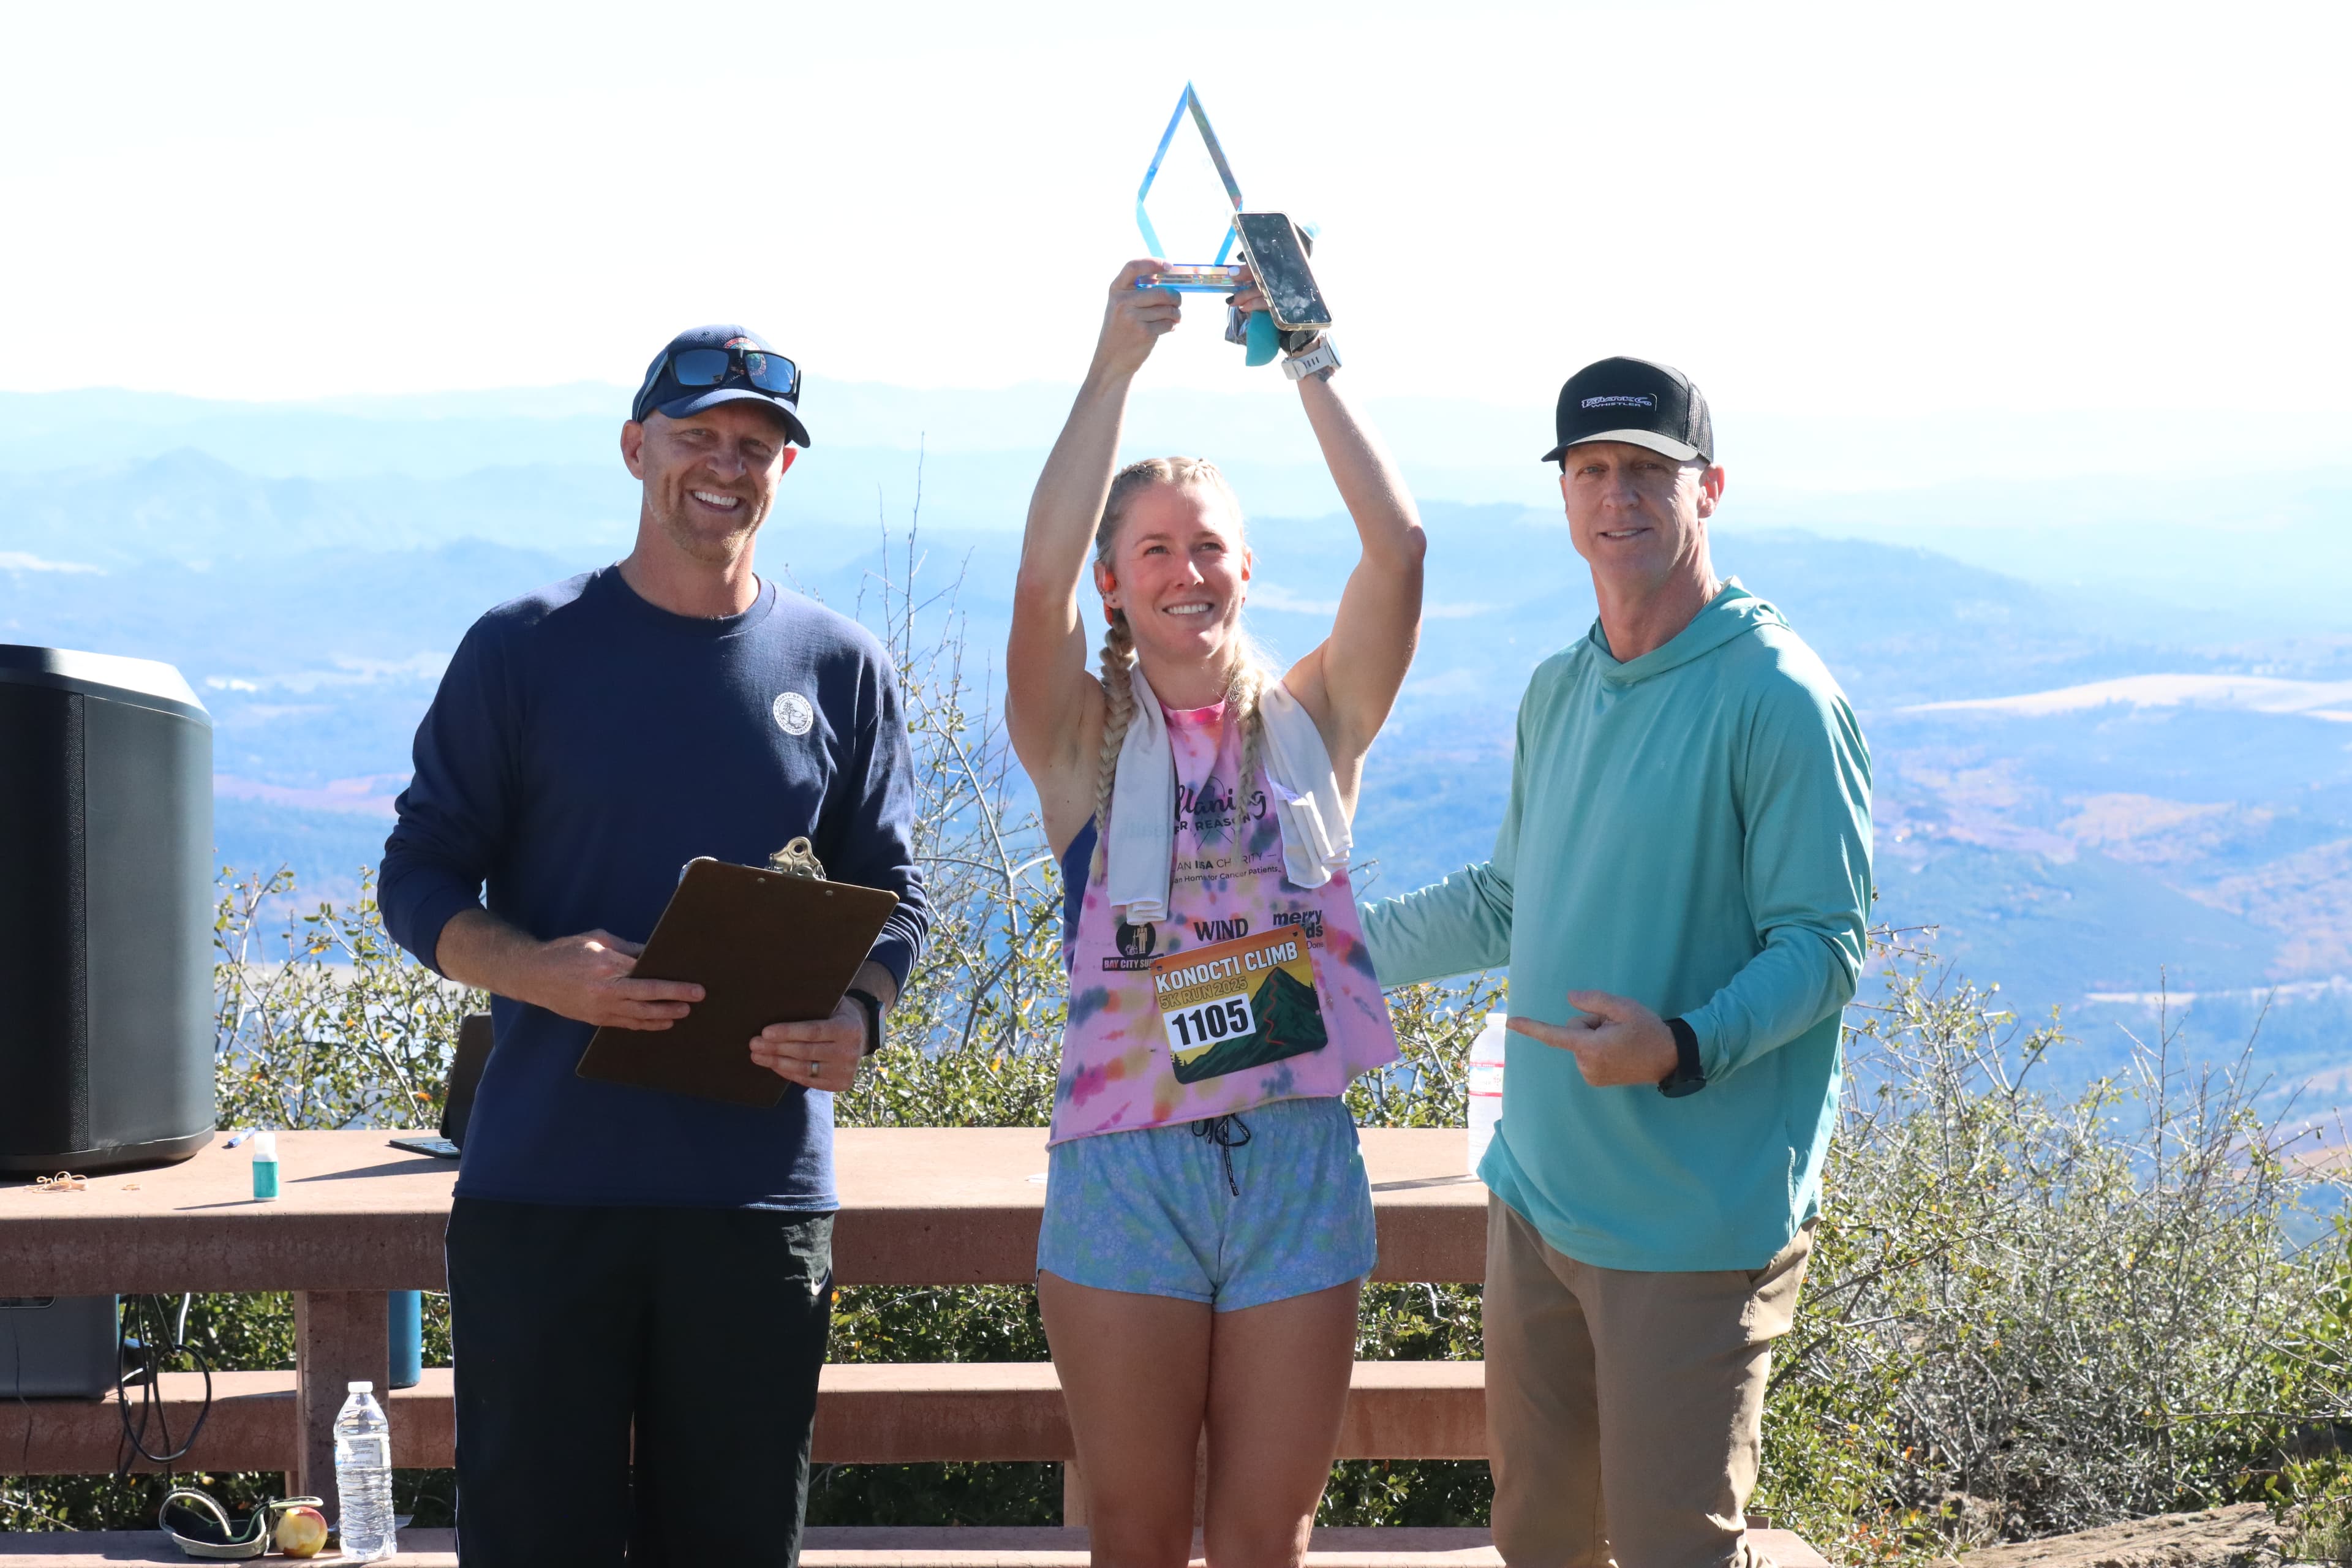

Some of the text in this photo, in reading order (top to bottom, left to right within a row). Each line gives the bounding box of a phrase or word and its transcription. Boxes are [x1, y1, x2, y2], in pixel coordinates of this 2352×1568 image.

[775, 693, 791, 706] COUNTY
[1177, 861, 1192, 871] AN
[1216, 852, 1263, 868] CHRITY
[1208, 872, 1218, 881] for
[1219, 870, 1247, 880] Cancer
[1273, 910, 1322, 925] merry
[1193, 918, 1249, 941] WIND
[1104, 959, 1119, 968] BAY
[1120, 959, 1139, 968] CITY
[1154, 941, 1298, 994] KONOCTI CLIMB
[1159, 976, 1248, 1009] 5K RUN 2025
[1172, 998, 1249, 1046] 1105
